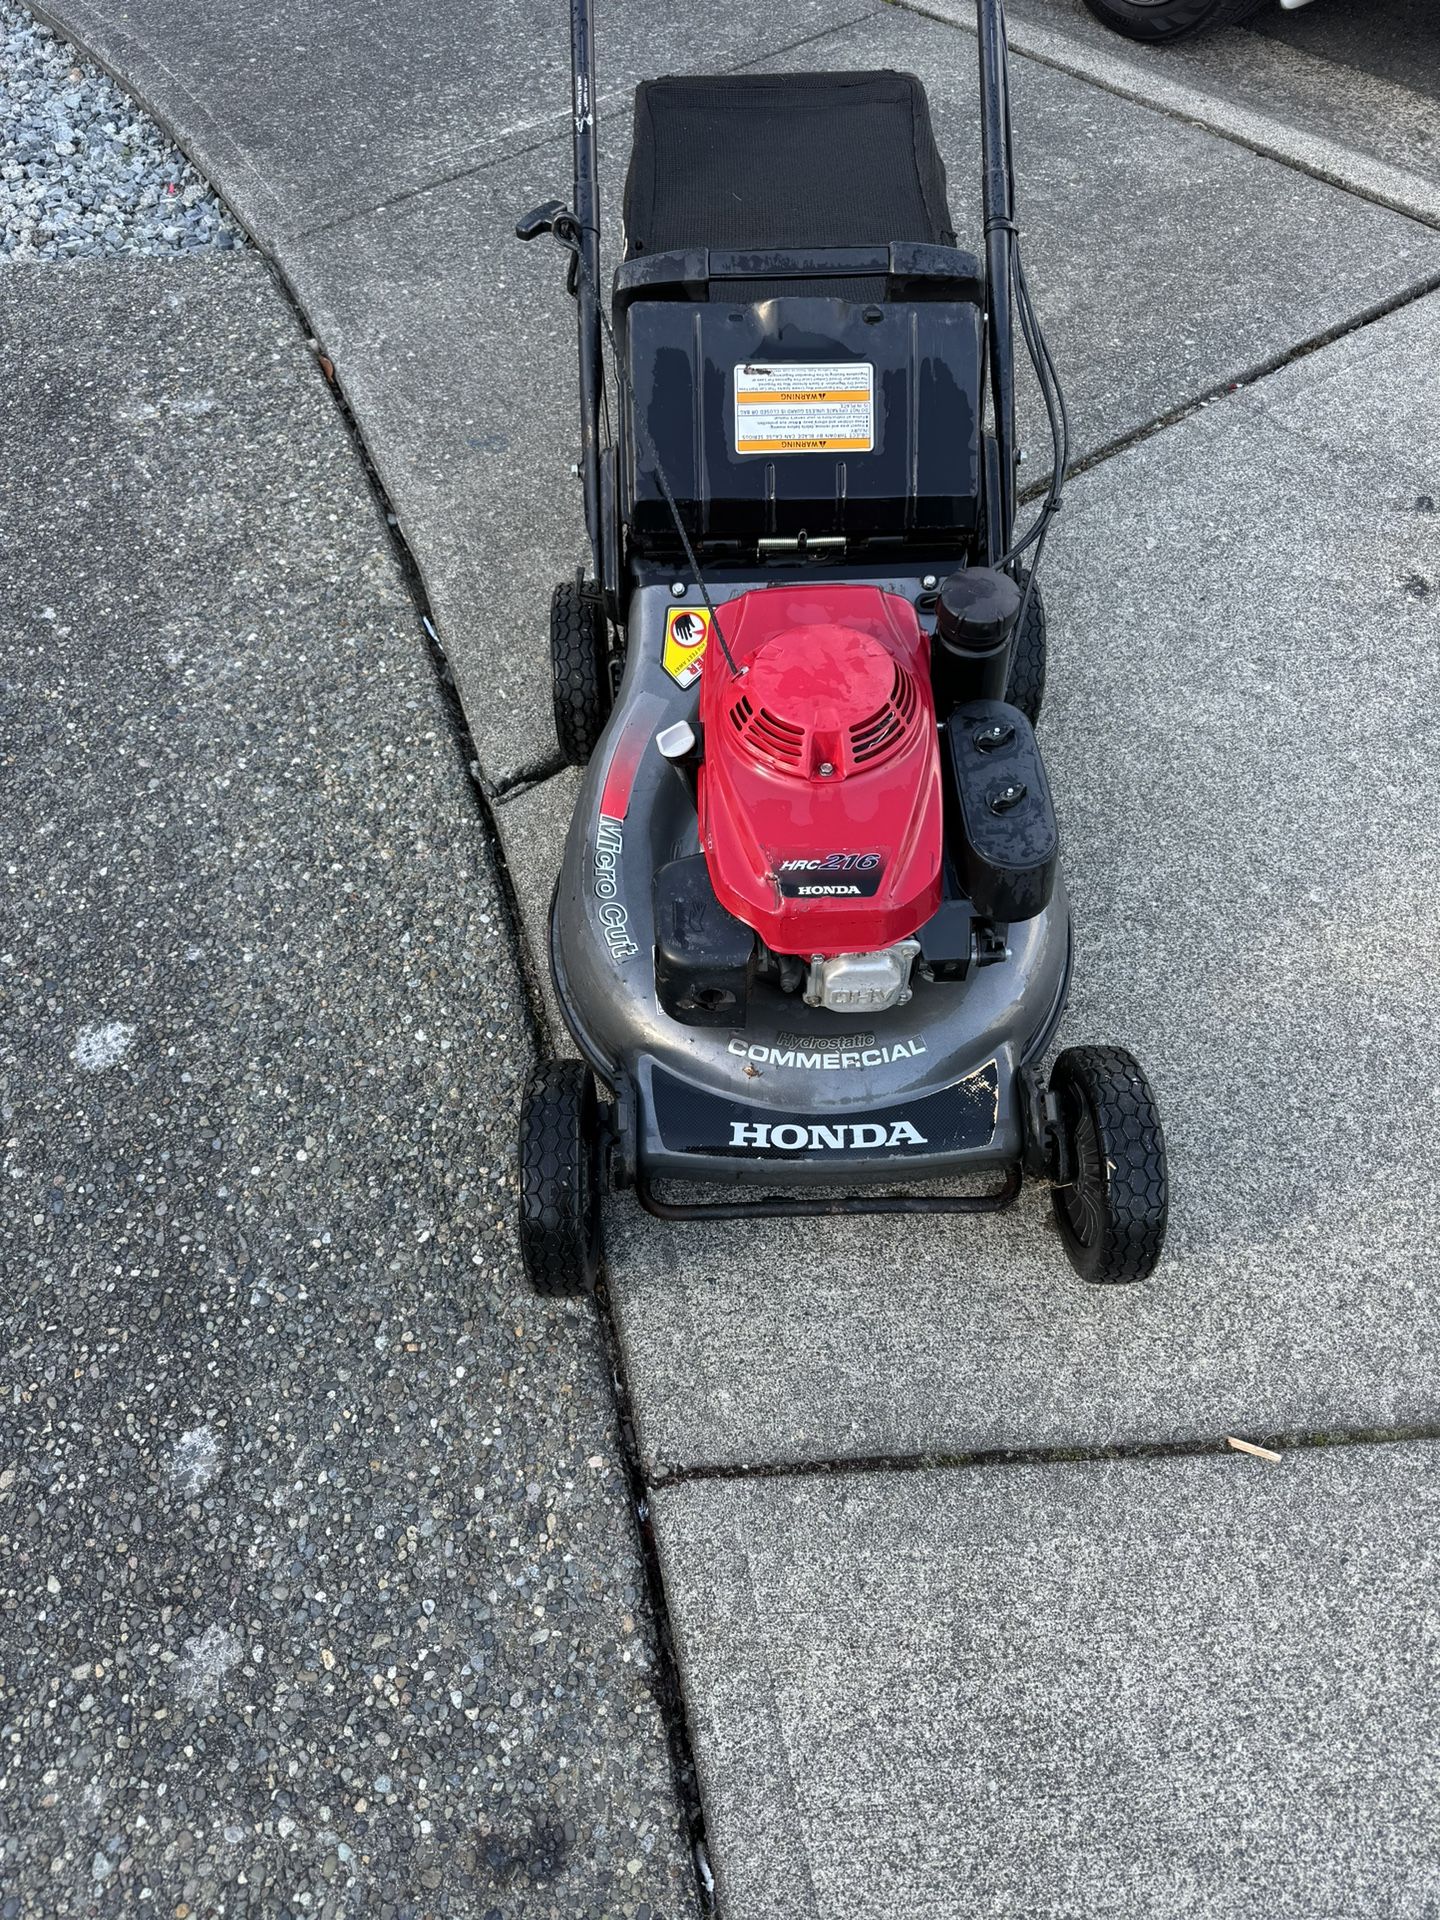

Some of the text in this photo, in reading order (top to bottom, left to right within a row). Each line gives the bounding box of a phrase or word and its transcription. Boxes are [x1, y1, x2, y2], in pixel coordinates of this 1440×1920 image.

[674, 660, 687, 673] AWAY
[594, 814, 638, 959] Micro Cut
[798, 885, 861, 895] HONDA
[829, 989, 893, 1005] OHV
[777, 1032, 875, 1050] Hydrostatic
[727, 1037, 927, 1070] COMMERCIAL
[728, 1121, 928, 1150] HONDA
